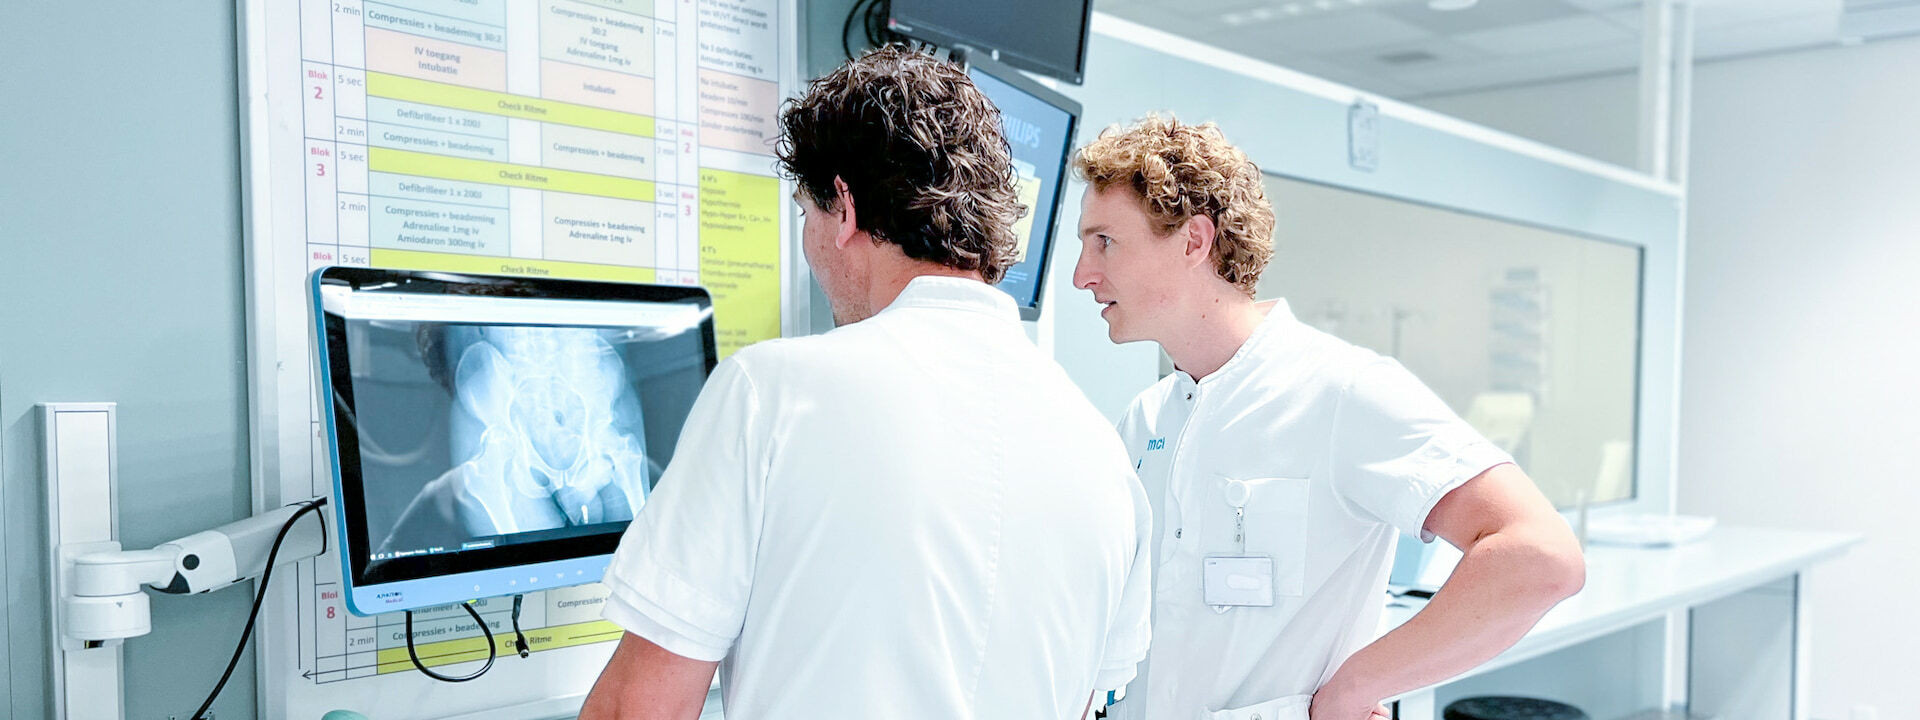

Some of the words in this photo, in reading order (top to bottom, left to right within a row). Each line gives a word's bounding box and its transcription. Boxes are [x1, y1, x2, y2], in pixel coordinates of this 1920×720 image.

[335, 3, 340, 12] 2
[342, 5, 361, 17] min
[368, 10, 425, 30] Compressies
[434, 23, 482, 41] beademing
[551, 6, 598, 23] Compressies
[605, 17, 644, 34] beademing
[414, 47, 424, 55] IV
[426, 48, 461, 63] toegang
[566, 47, 606, 61] Adrenaline
[307, 69, 328, 80] Blok
[418, 60, 458, 75] Intubatie
[338, 74, 344, 84] 5
[346, 76, 363, 86] sec
[314, 86, 323, 100] 2
[583, 82, 616, 95] Intubatie
[498, 100, 521, 111] Check
[524, 103, 547, 115] Ritme
[397, 108, 446, 125] Defibrilleer
[339, 125, 344, 134] 2
[347, 127, 365, 137] min
[383, 131, 438, 148] Compressies
[448, 140, 495, 155] beademing
[685, 143, 691, 153] 2
[310, 147, 330, 157] Blok
[341, 152, 347, 160] 5
[349, 153, 364, 162] sec
[553, 142, 599, 157] Compressies
[607, 150, 645, 164] beademing
[316, 163, 326, 177] 3
[499, 170, 523, 182] Check
[525, 173, 548, 184] Ritme
[399, 182, 448, 197] Defibrilleer
[340, 202, 346, 210] 2
[349, 203, 366, 212] min
[685, 205, 691, 216] 3
[385, 206, 440, 219] Compressies
[449, 212, 495, 225] beademing
[403, 221, 450, 233] Adrenaline
[452, 224, 469, 235] 1mg
[472, 226, 479, 234] iv
[554, 216, 600, 228] Compressies
[607, 221, 645, 234] beademing
[397, 234, 446, 246] Amiodaron
[448, 237, 475, 249] 300mg
[477, 240, 485, 249] iv
[569, 230, 608, 241] Adrenaline
[610, 234, 625, 244] 1mg
[313, 252, 332, 261] Blok
[343, 255, 348, 263] 5
[351, 256, 366, 264] sec
[501, 265, 524, 274] Check
[527, 267, 549, 275] Ritme
[557, 596, 603, 609] Compressies
[327, 606, 336, 619] 8
[393, 626, 447, 641] Copressies
[456, 620, 500, 633] beadeing
[350, 638, 355, 646] 2
[357, 635, 375, 646] min
[530, 636, 552, 645] Ritme
